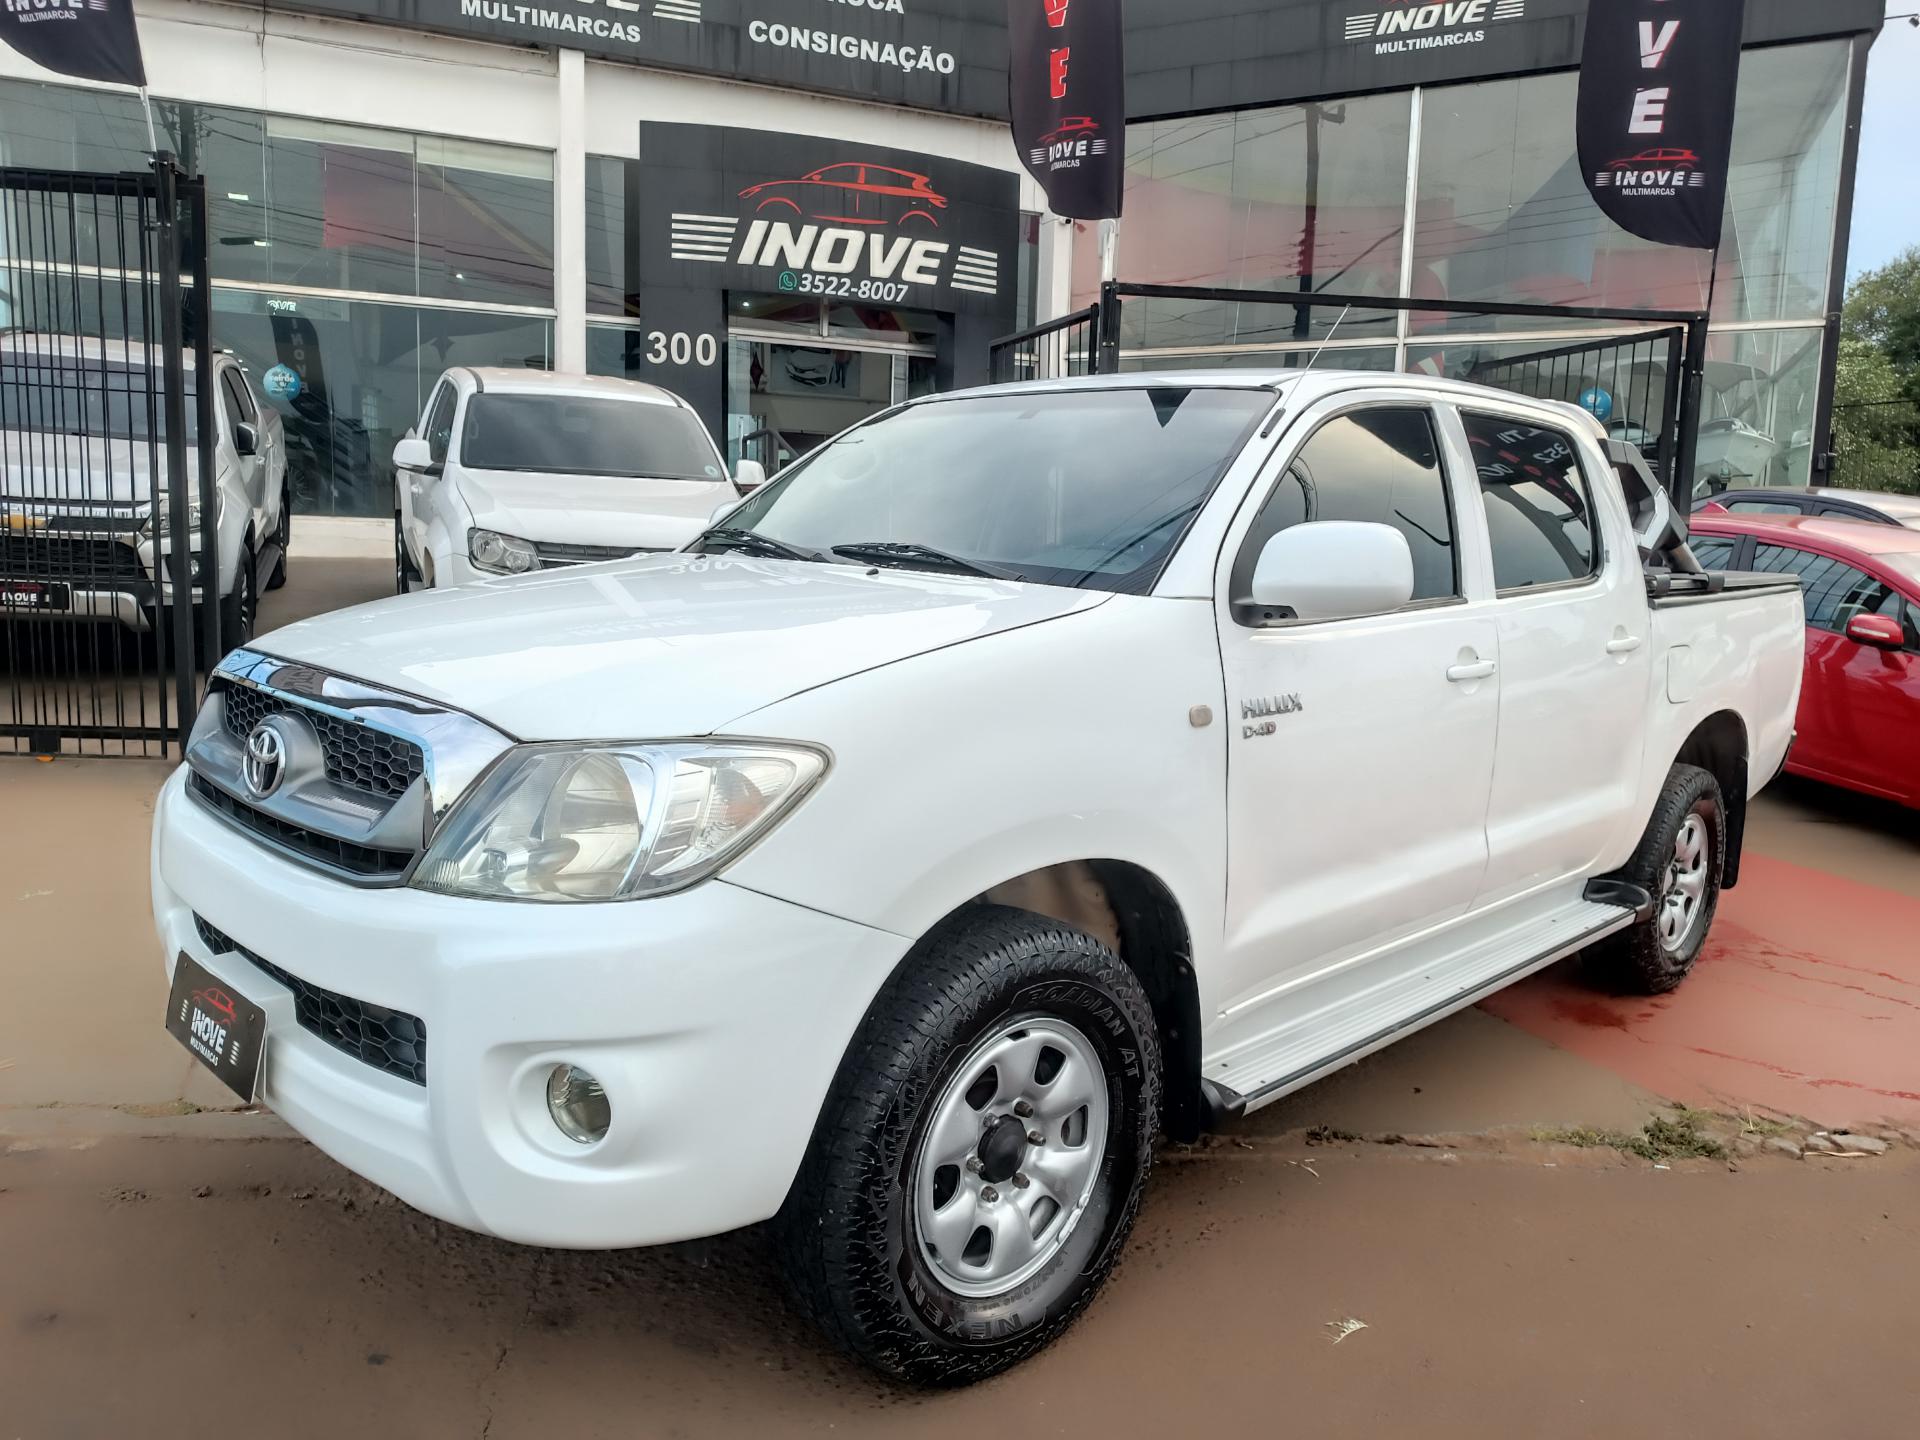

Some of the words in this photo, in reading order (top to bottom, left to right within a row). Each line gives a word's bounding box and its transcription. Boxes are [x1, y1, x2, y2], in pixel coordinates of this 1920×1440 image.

[18, 10, 77, 23] MULTIMARCAS
[461, 0, 641, 43] MULTIMARCAS
[1375, 0, 1491, 36] INOVE
[748, 20, 955, 74] CONSIGNAÇÃO
[1375, 30, 1485, 55] MULTIMARCAS
[1627, 0, 1681, 134] VE
[1615, 171, 1686, 186] INOVE
[1621, 187, 1676, 197] MULTIMARCAS
[737, 219, 950, 286] INOVE
[798, 273, 909, 303] 3522-8007
[646, 331, 718, 367] 300
[1241, 692, 1303, 720] HILUX
[190, 1007, 227, 1055] INOVE
[189, 1036, 219, 1067] MULTIMARCAS
[1118, 1047, 1141, 1079] AT
[906, 1270, 1024, 1341] NEXEN
